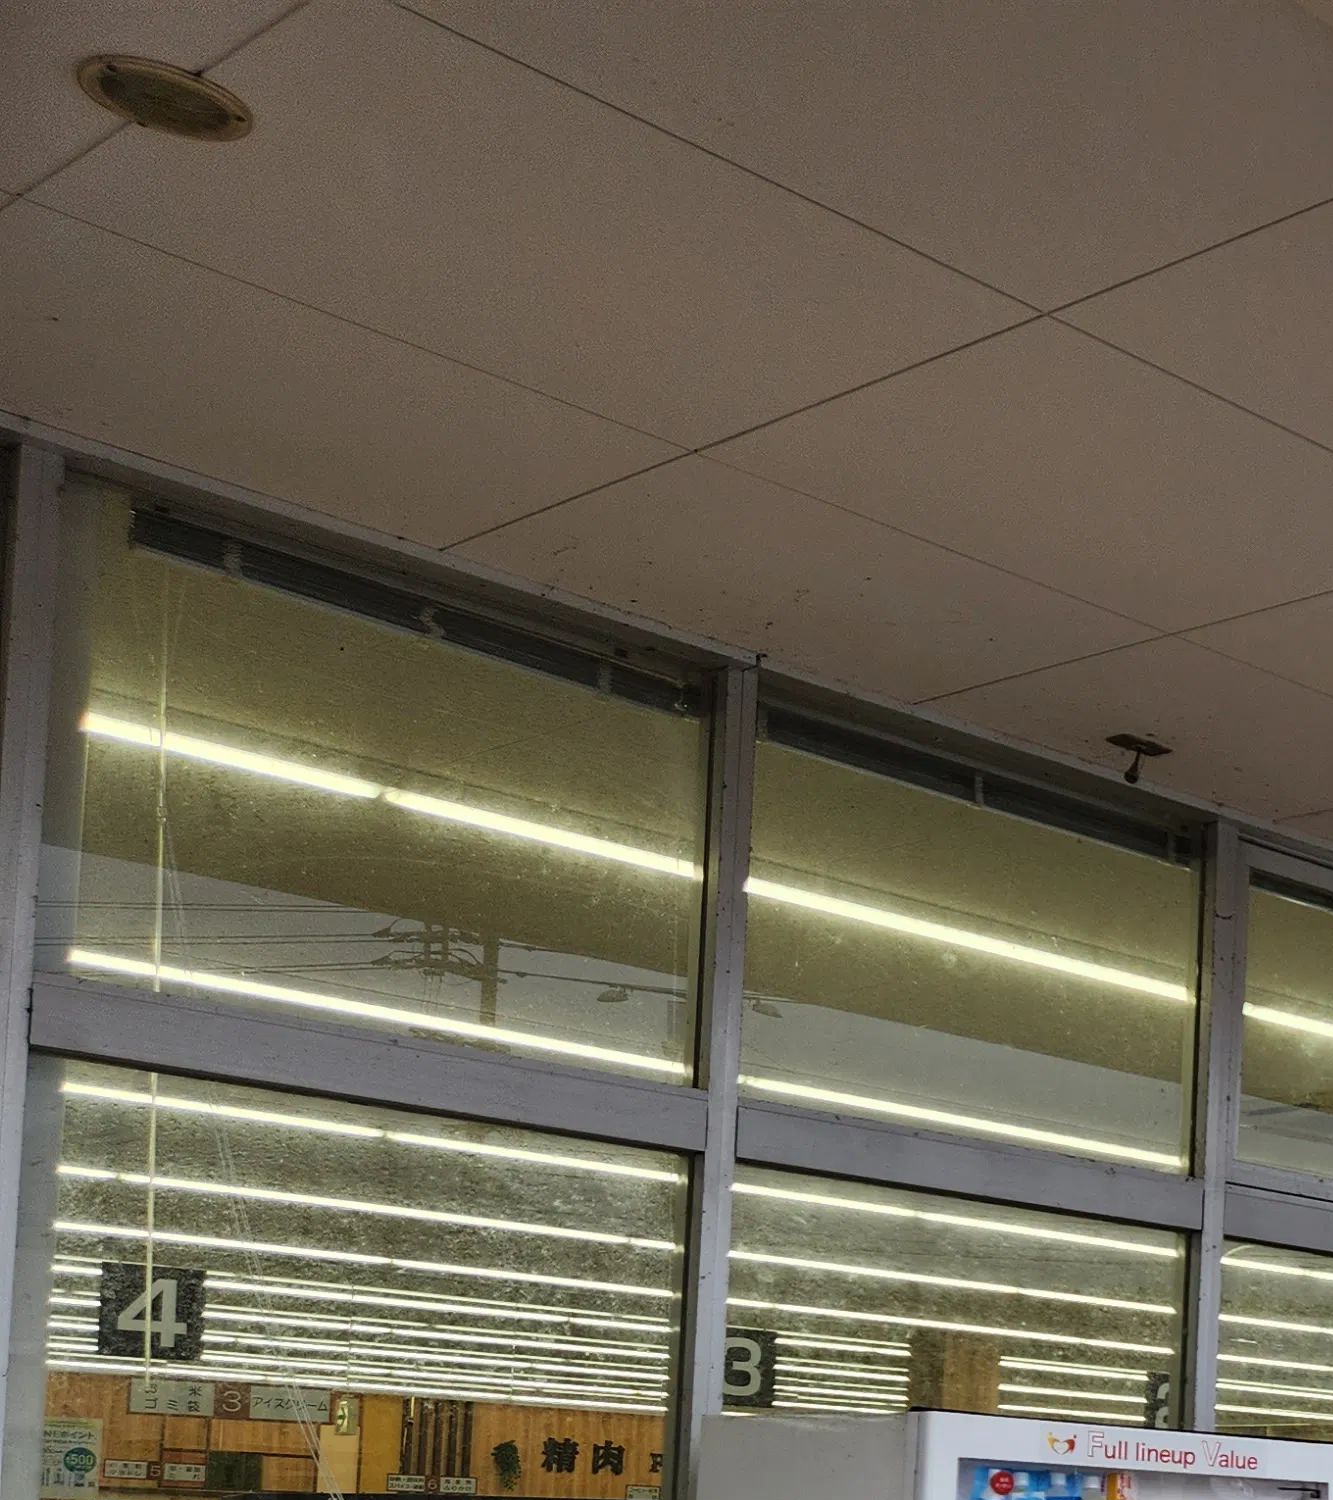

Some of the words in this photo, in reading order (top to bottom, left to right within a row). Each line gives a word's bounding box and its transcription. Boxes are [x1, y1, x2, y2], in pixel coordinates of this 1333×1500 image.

[116, 1278, 187, 1348] 4
[723, 1337, 762, 1397] 3
[222, 1390, 242, 1413] 3
[251, 1395, 329, 1413] アイスクリーム
[541, 1437, 626, 1476] 精肉
[1087, 1430, 1129, 1461] Full
[1135, 1442, 1196, 1469] lineup
[1201, 1440, 1258, 1470] Value
